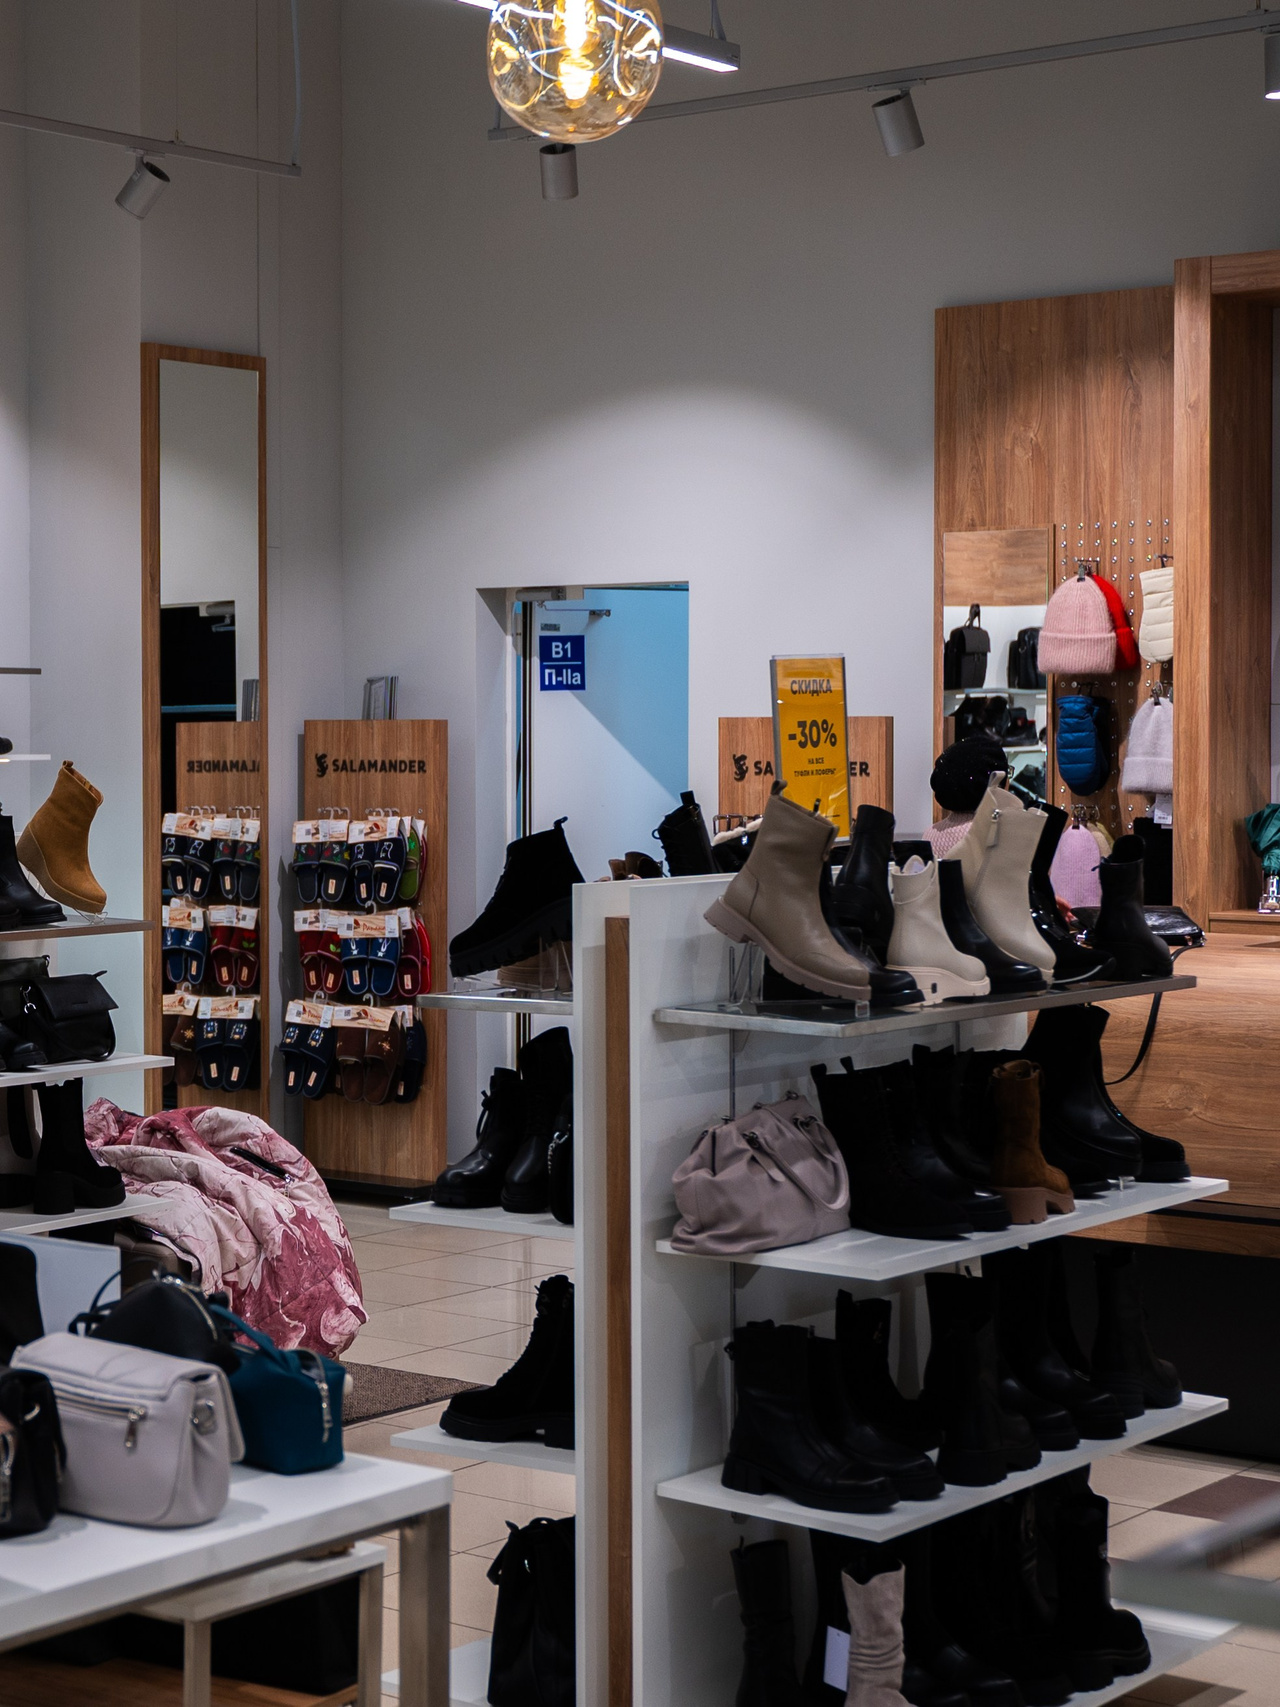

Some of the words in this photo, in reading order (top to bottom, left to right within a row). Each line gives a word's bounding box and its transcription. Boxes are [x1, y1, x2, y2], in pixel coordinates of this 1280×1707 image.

[790, 679, 832, 697] СКИДКА
[788, 719, 837, 749] -30%
[332, 759, 427, 774] SALAMANDER
